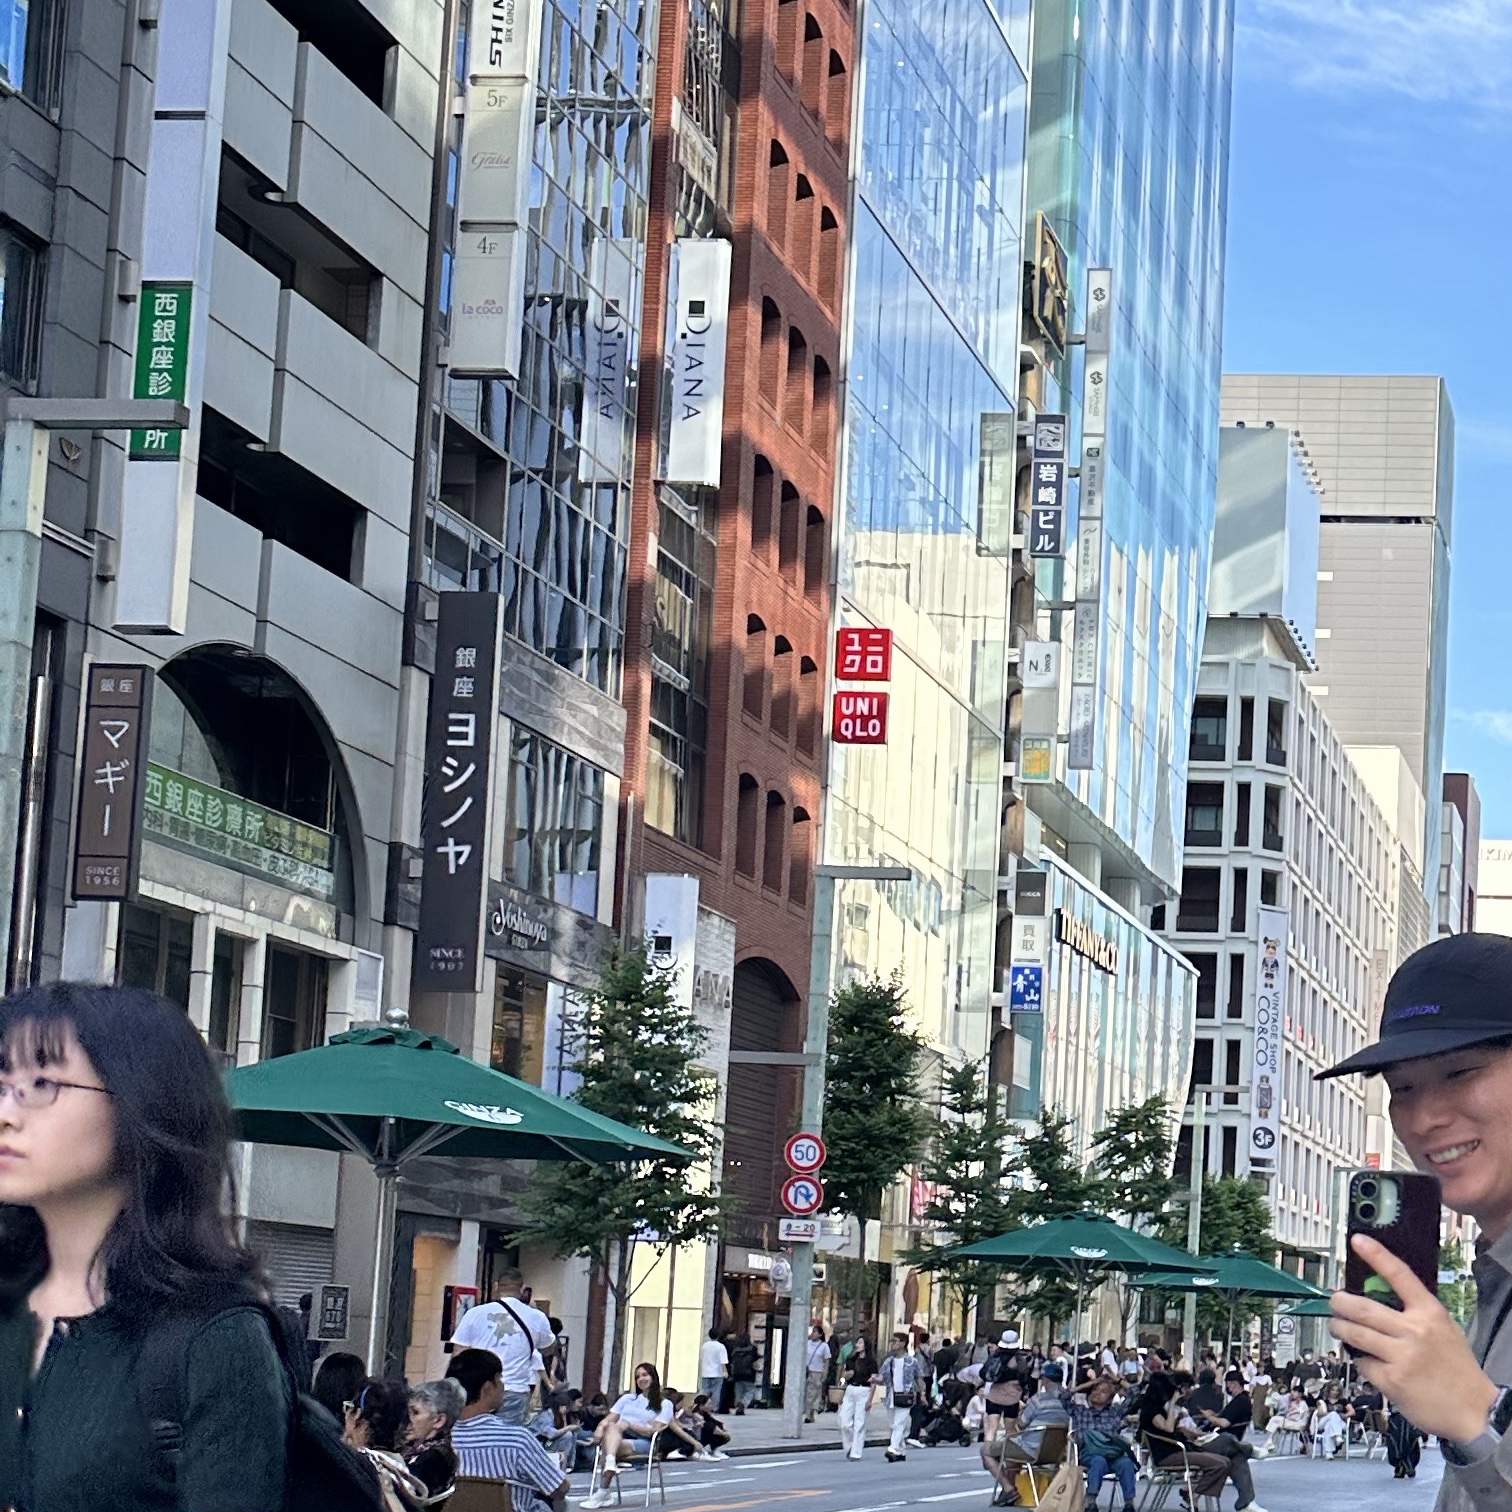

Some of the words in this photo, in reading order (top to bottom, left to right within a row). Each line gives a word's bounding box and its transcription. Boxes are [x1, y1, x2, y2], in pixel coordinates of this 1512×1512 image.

[506, 0, 515, 25] GINZ
[487, 89, 508, 107] 5F
[477, 236, 498, 253] 4F
[143, 292, 180, 450] 西銀座診所
[681, 301, 712, 421] DIANA
[1035, 464, 1058, 551] 岩崎ビル
[845, 633, 884, 651] ユニ
[842, 655, 884, 673] クロ
[100, 678, 134, 693] 銀座
[841, 697, 879, 715] UNI
[840, 718, 881, 740] QLO
[94, 720, 130, 837] マギー
[144, 769, 265, 844] 西銀座診療所
[85, 866, 121, 876] SINCE
[85, 876, 121, 886] 1956
[1022, 924, 1036, 952] 買取
[429, 948, 465, 958] SINCE
[1268, 990, 1280, 1042] VINTAGE
[1255, 995, 1271, 1067] CO&CO
[1268, 1043, 1278, 1074] SHOP
[1253, 1128, 1273, 1146] 3F
[794, 1144, 817, 1162] 50
